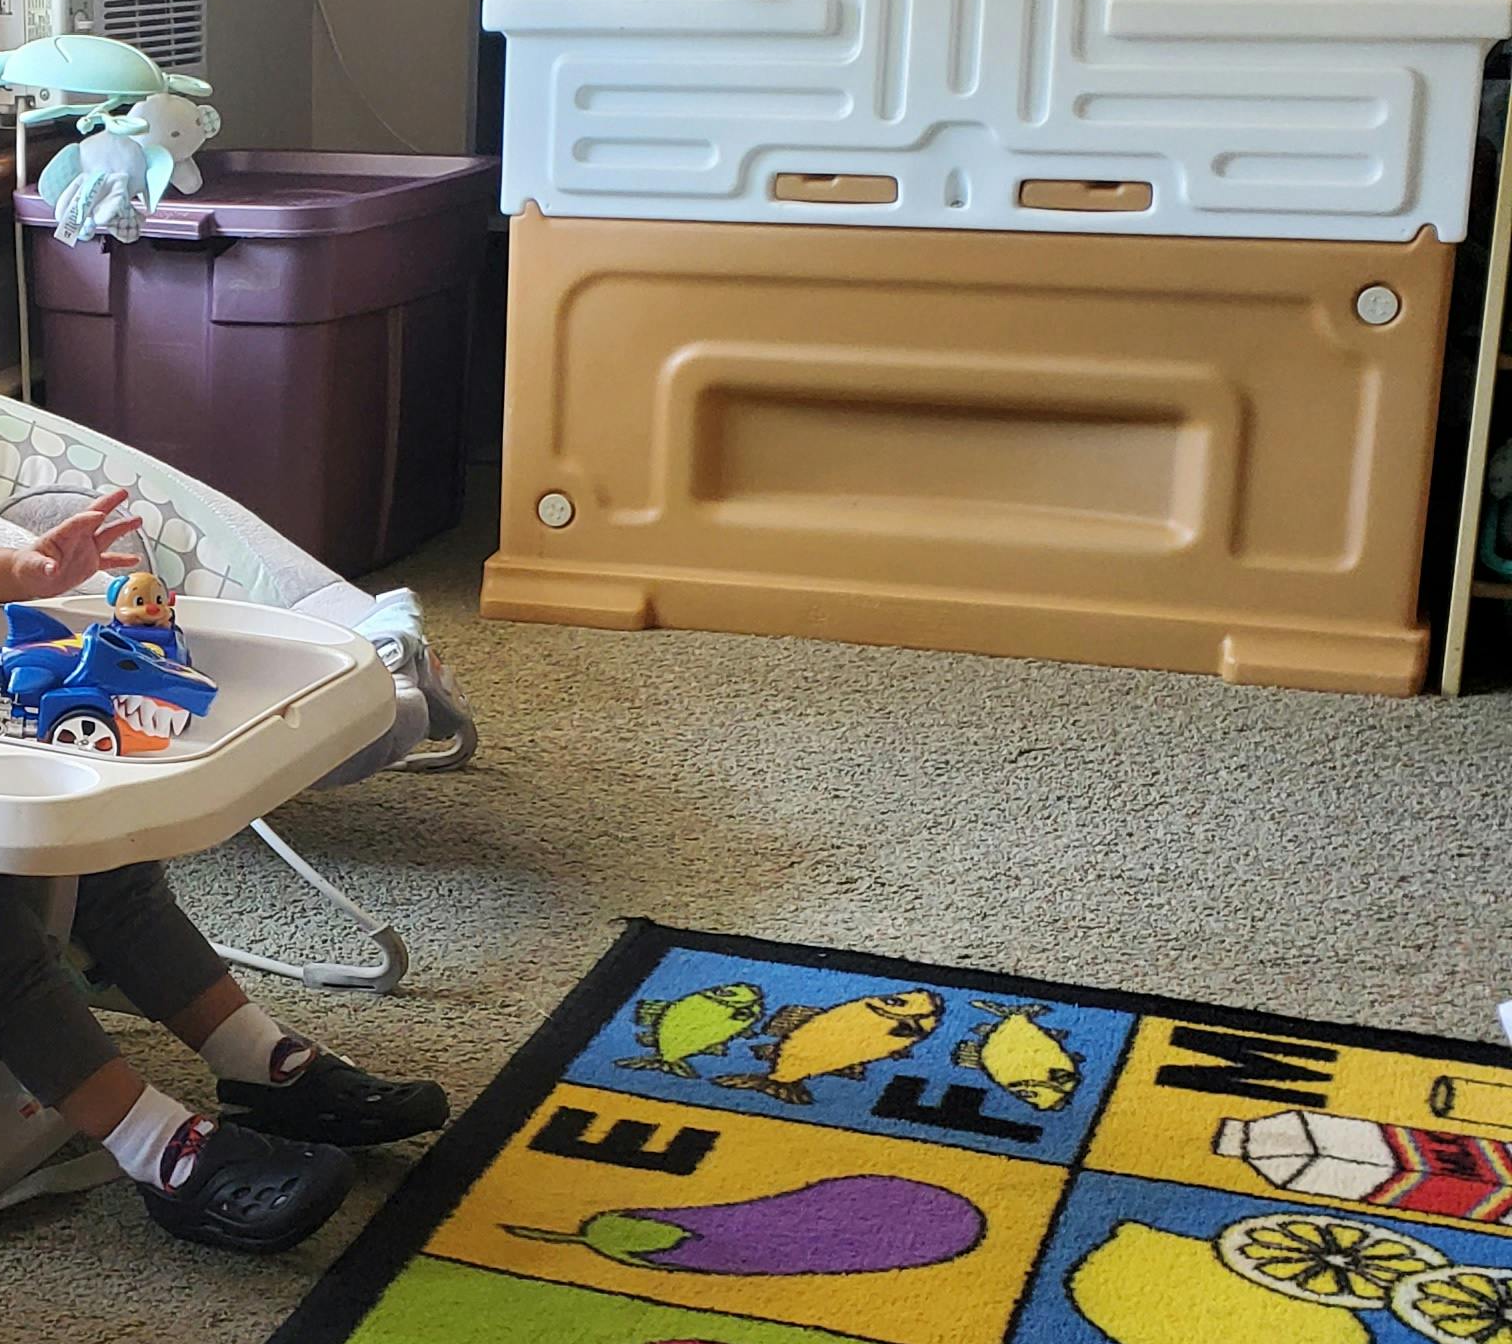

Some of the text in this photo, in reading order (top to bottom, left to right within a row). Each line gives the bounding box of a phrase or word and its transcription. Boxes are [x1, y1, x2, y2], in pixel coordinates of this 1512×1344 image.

[1154, 1024, 1340, 1109] M
[529, 1105, 722, 1176] E
[870, 1074, 1044, 1144] F
